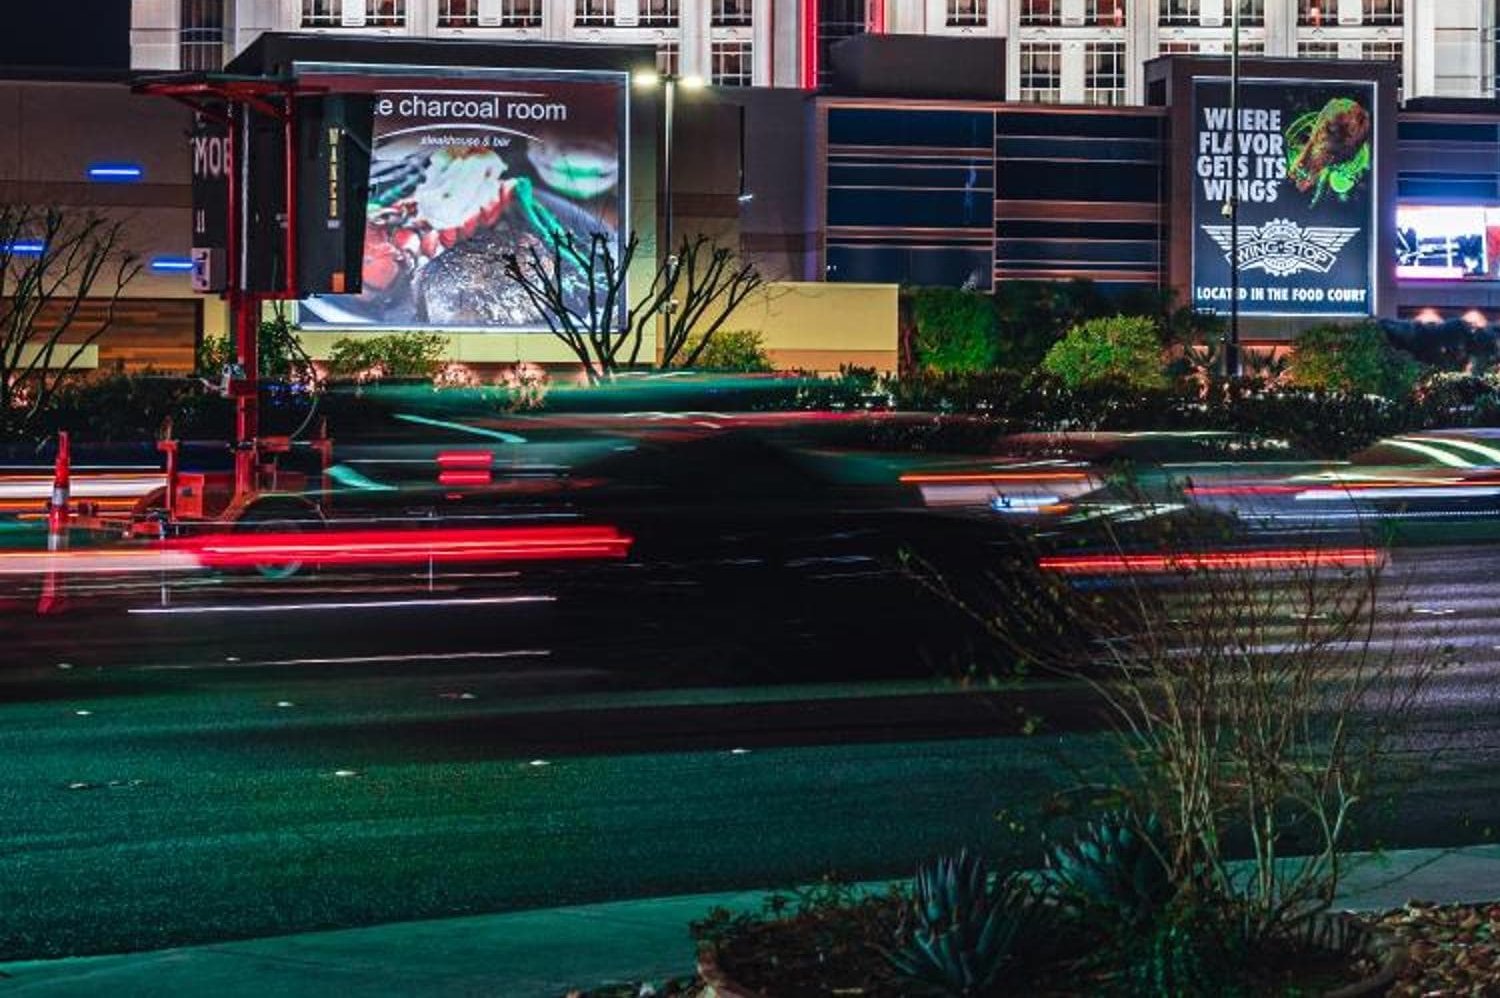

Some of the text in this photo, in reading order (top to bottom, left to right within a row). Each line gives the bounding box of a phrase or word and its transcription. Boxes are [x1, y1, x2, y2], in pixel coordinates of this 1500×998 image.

[400, 95, 499, 119] charcoal
[507, 102, 567, 120] room
[1203, 107, 1281, 131] WHERE
[1199, 131, 1285, 155] FLAVOR
[1197, 155, 1287, 179] GETS ITS
[1197, 286, 1367, 302] LOCATD IN THE FOOD COURT
